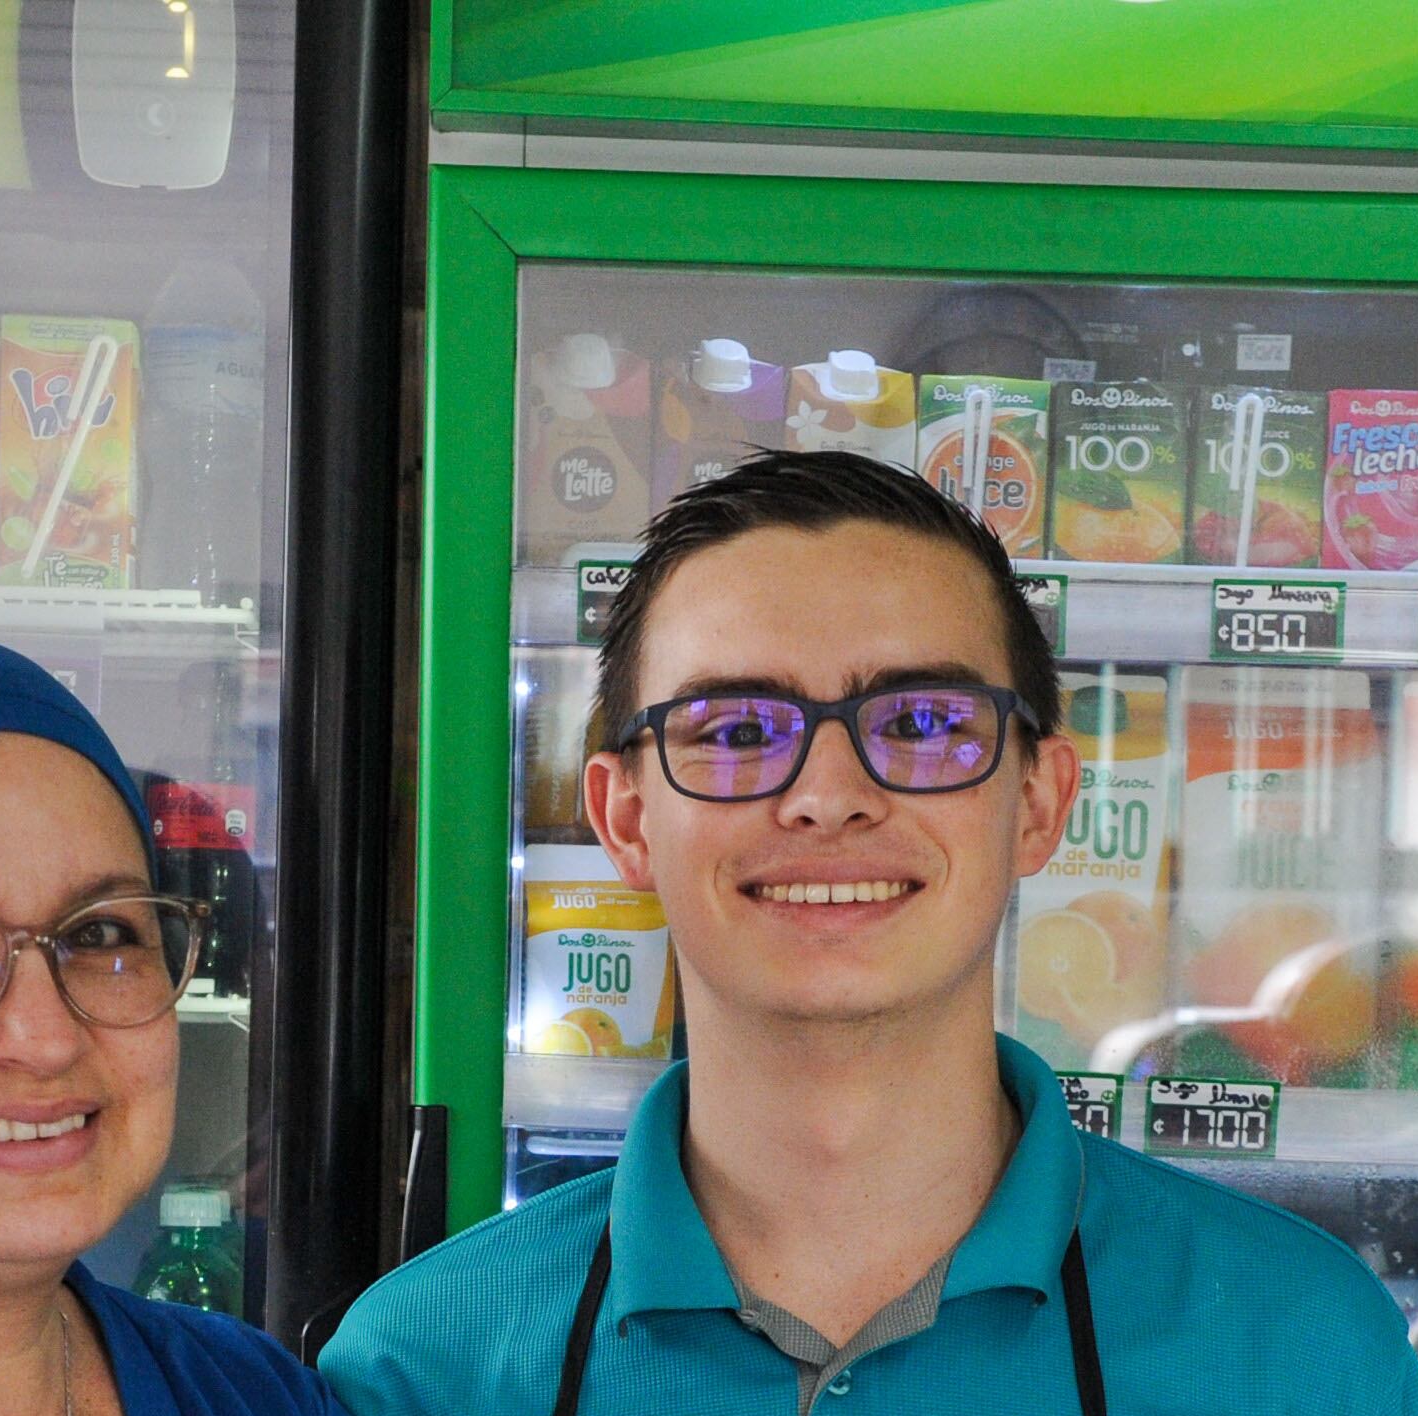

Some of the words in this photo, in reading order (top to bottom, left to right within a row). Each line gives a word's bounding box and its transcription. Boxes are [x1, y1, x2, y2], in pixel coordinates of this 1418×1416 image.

[934, 385, 967, 402] Dos
[1071, 388, 1102, 406] Dos
[1119, 391, 1173, 408] Pinos
[1262, 397, 1314, 414] Pinos
[1080, 423, 1106, 431] JUGO
[1116, 424, 1161, 432] NARANJA
[560, 458, 588, 473] me
[694, 462, 723, 477] me
[565, 469, 613, 500] Latte
[1218, 613, 1306, 652] ¢850
[1096, 771, 1155, 790] Pinos
[1065, 799, 1148, 862] UGO
[1066, 849, 1087, 862] de
[1047, 862, 1141, 881] naranja
[552, 895, 596, 910] JUGO
[559, 934, 580, 947] Dos
[597, 935, 635, 948] Pinos
[563, 952, 630, 993] JUGO
[578, 984, 593, 994] de
[565, 993, 627, 1006] naranja
